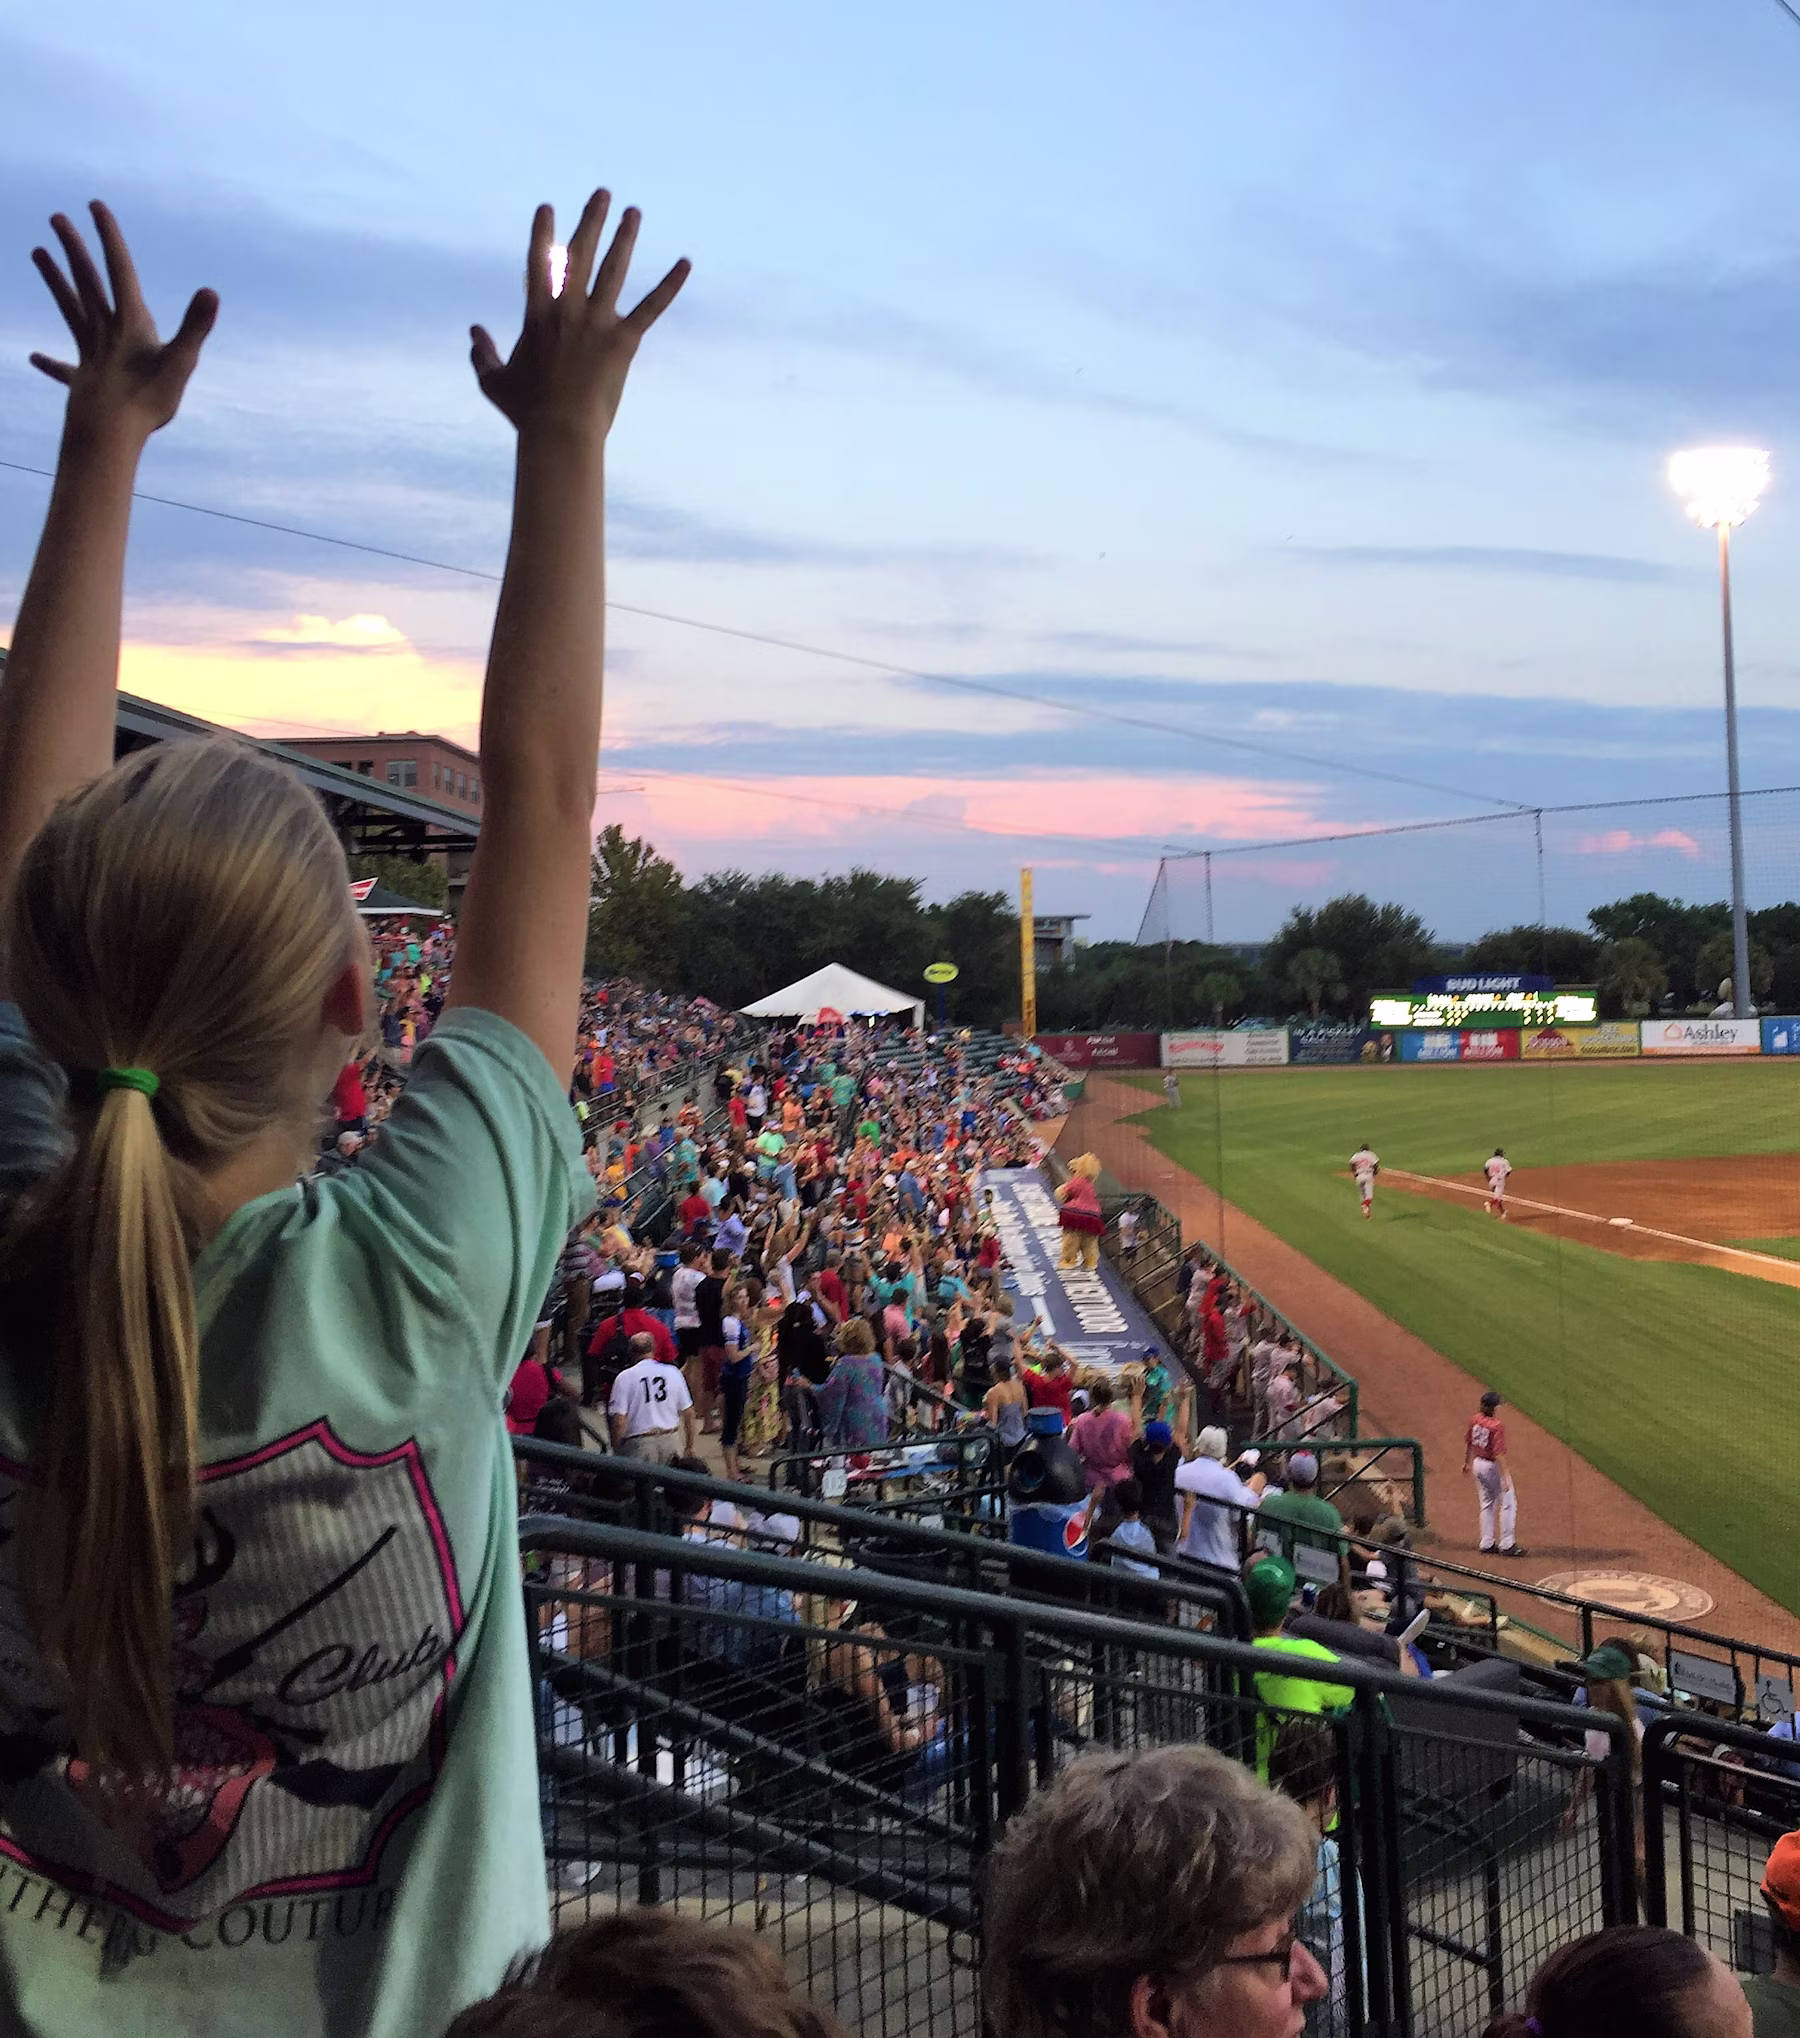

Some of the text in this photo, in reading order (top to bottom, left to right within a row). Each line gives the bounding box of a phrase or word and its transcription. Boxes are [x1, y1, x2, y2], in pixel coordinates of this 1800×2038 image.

[1446, 976, 1521, 992] BUD LIGHT
[1684, 1023, 1738, 1042] Ashley
[640, 1376, 667, 1403] 13
[278, 1624, 443, 1706] Club
